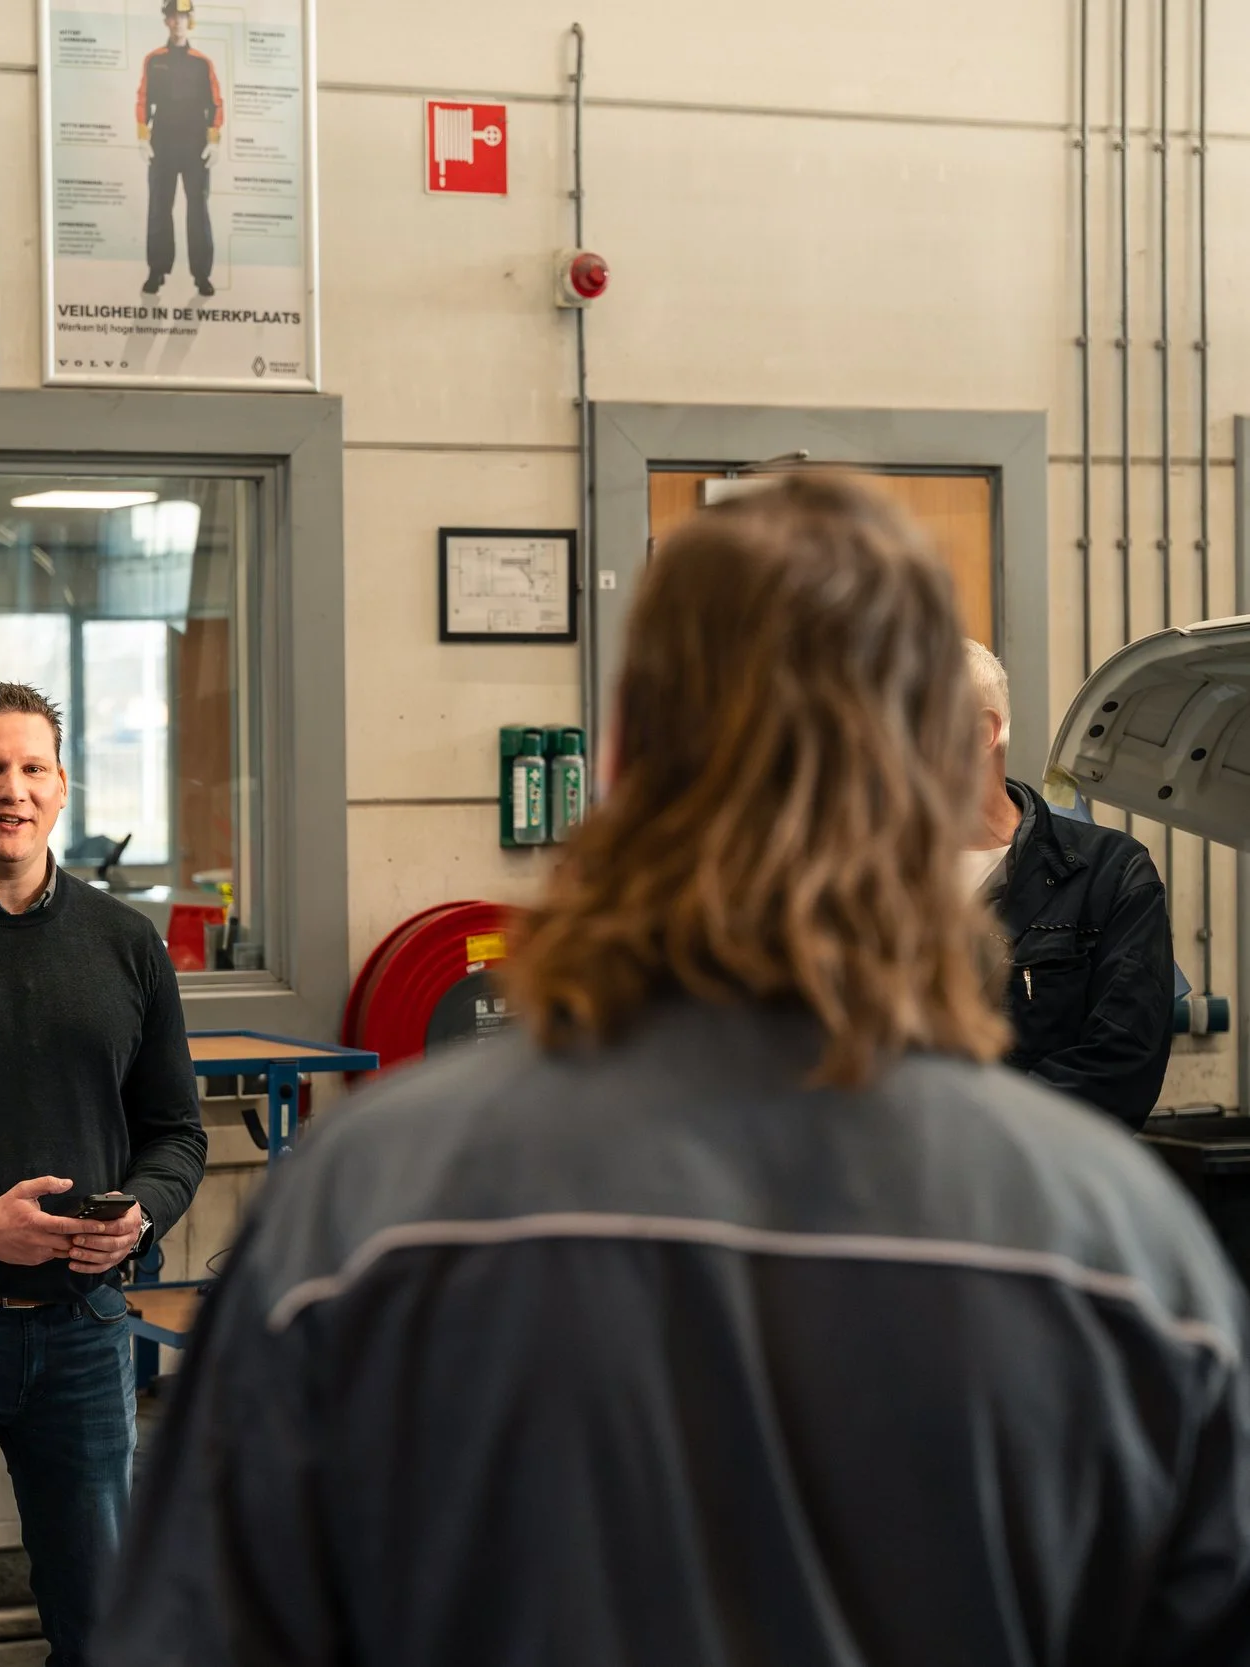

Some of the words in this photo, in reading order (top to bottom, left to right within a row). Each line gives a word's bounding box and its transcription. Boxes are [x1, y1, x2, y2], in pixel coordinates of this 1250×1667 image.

[58, 304, 148, 320] VEILIGHEID
[152, 307, 168, 320] IN
[173, 308, 193, 321] DE
[196, 309, 301, 325] WERKPLAATS
[57, 322, 95, 333] Werken
[96, 323, 109, 335] bij
[110, 324, 134, 336] hoge
[135, 325, 198, 336] temperaturen
[58, 359, 129, 369] VOLVO
